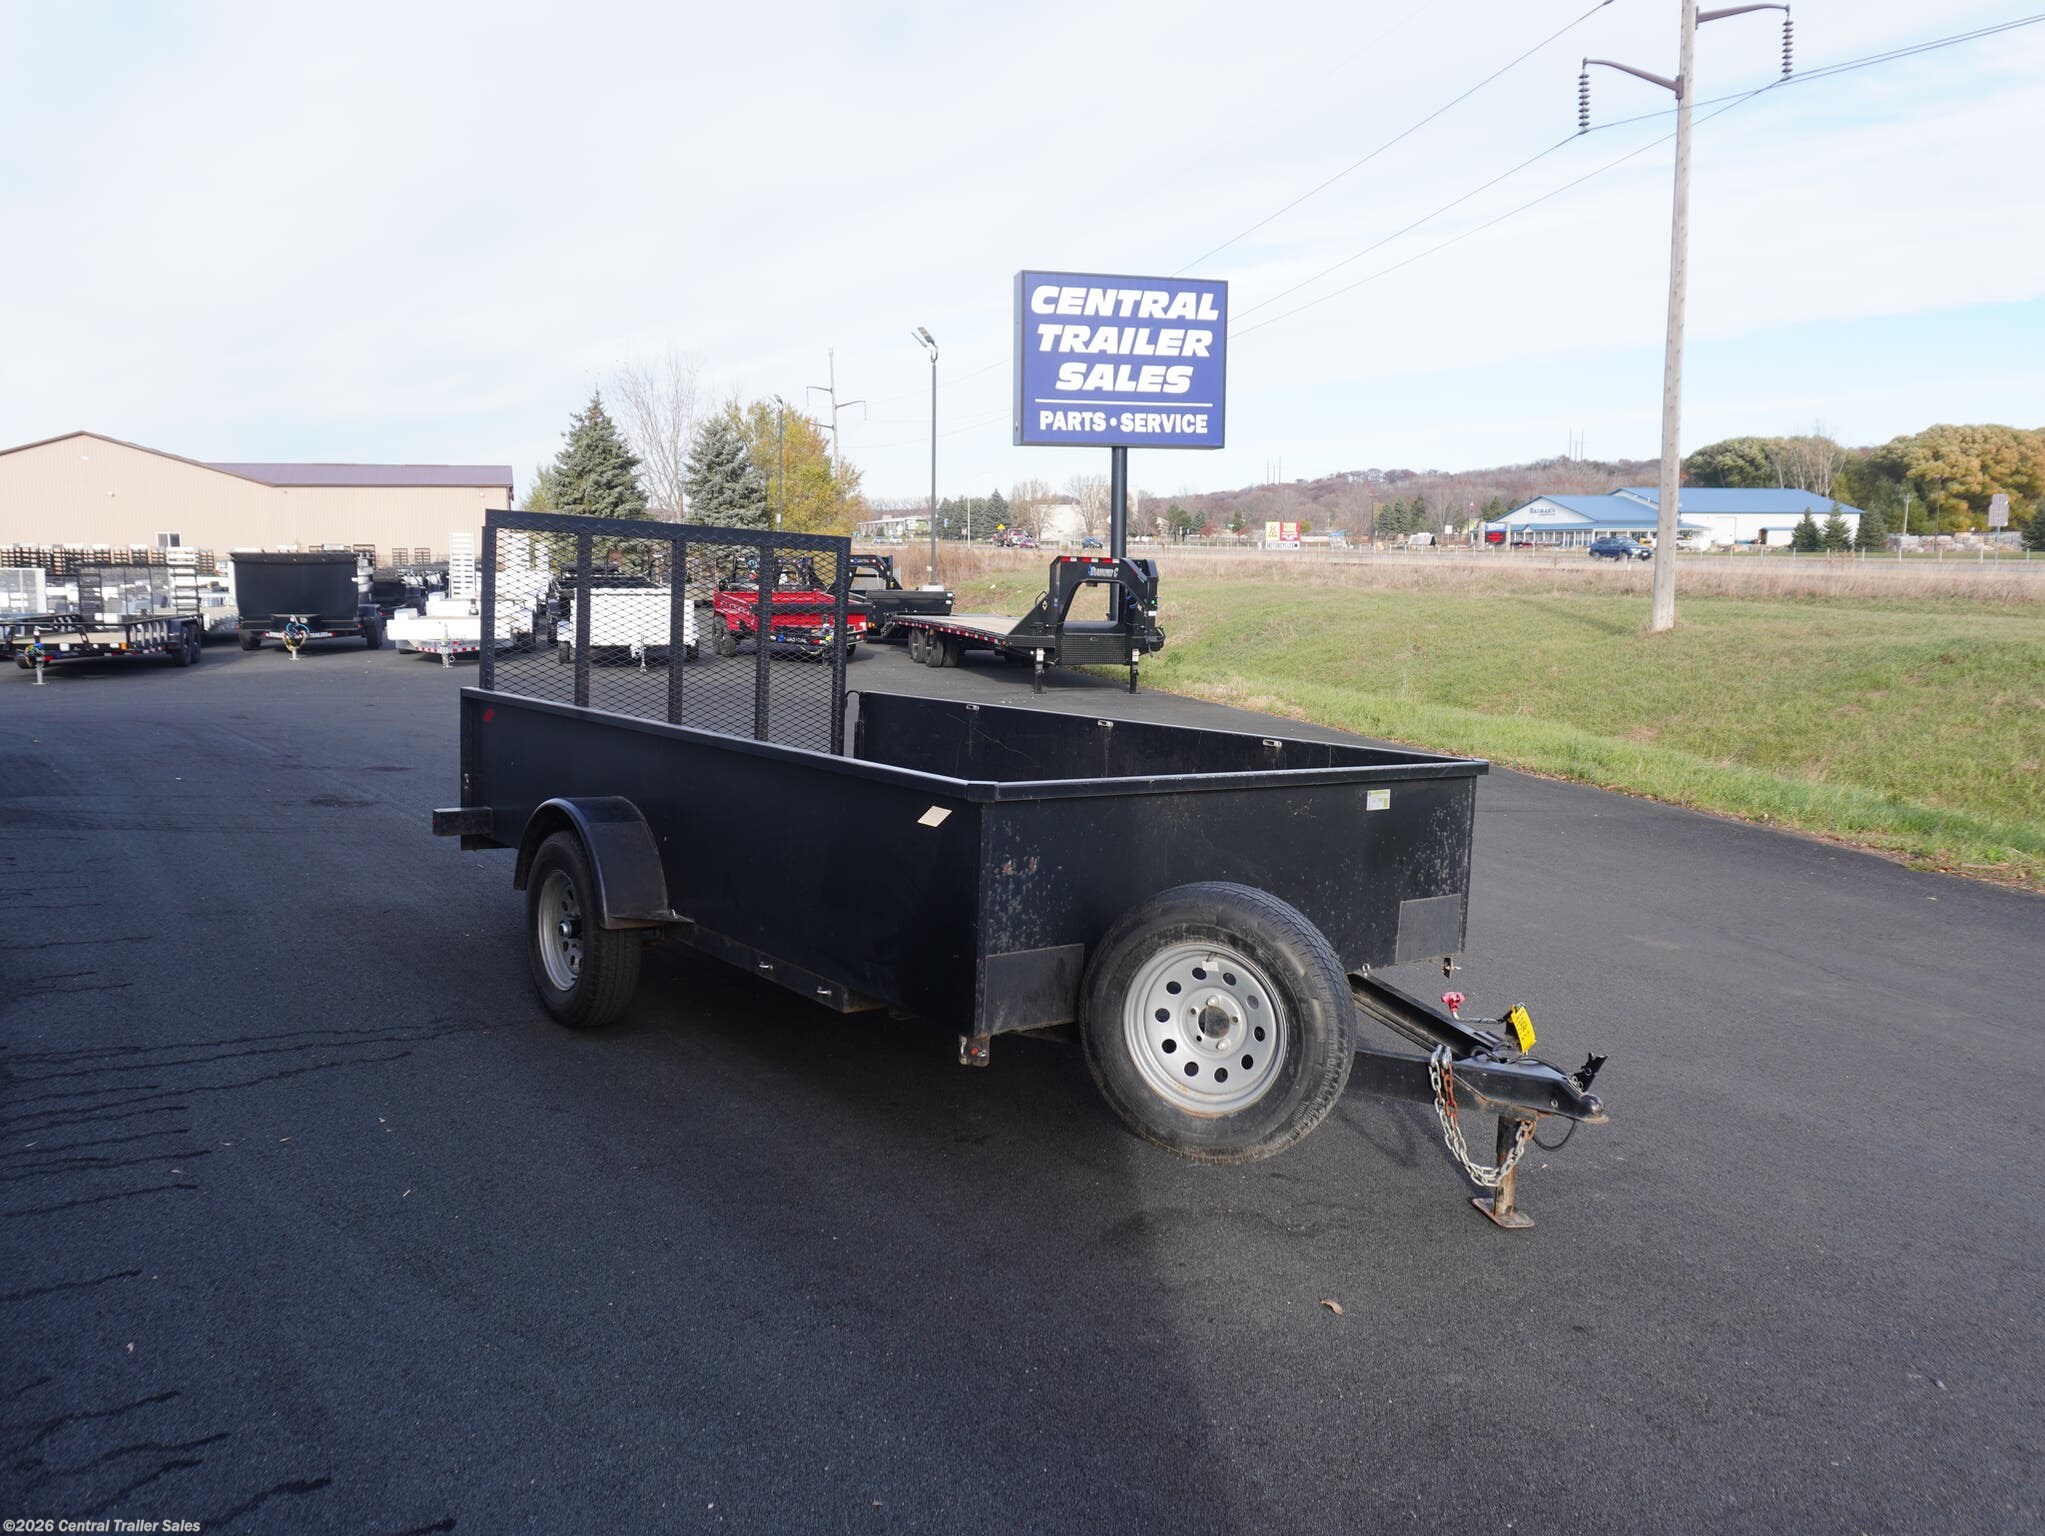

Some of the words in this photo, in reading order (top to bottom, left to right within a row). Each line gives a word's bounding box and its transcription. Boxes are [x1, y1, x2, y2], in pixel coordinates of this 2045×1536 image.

[1031, 285, 1219, 321] CENTRAL
[1037, 323, 1213, 358] TRAILER
[1055, 361, 1194, 394] SALES
[1039, 410, 1107, 432] PARTS
[1119, 412, 1208, 434] SERVICE
